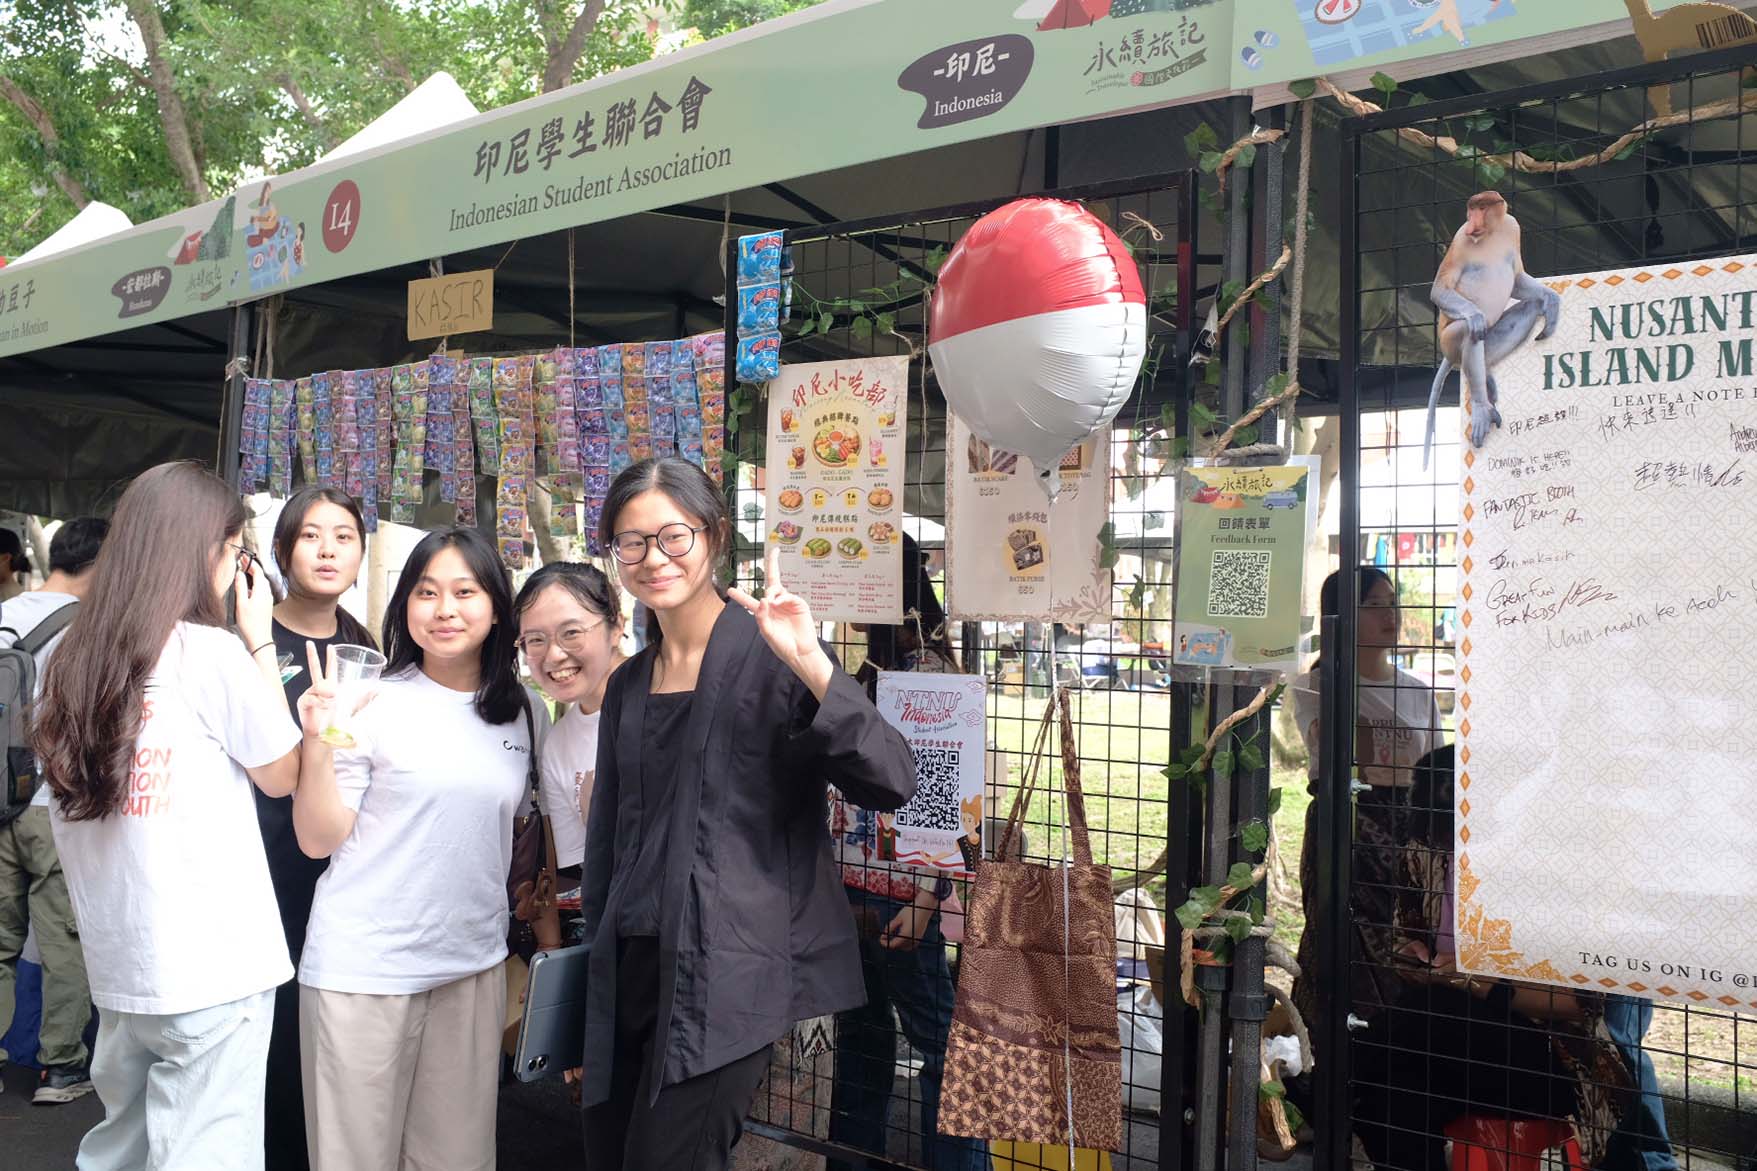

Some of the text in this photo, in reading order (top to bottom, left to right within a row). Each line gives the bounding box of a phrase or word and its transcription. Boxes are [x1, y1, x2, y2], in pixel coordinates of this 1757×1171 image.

[1083, 15, 1205, 76] 永續旅記
[934, 88, 1003, 117] Indonesia
[473, 75, 713, 184] 印尼學生聯合會
[449, 146, 732, 232] Indonesian Student Association
[414, 279, 484, 328] KASIR
[1588, 290, 1757, 342] NUSANT
[1542, 338, 1754, 390] ISLAND M
[1613, 388, 1745, 407] LEAVE A NOTE
[1483, 492, 1539, 519] FANTASTIC
[1546, 485, 1575, 502] BOOTH
[1210, 534, 1277, 544] Feedback Form
[1218, 517, 1271, 530] 回饋表單
[895, 689, 962, 712] NTNU
[901, 703, 952, 724] Indonesia
[1578, 951, 1618, 968] TAG
[1627, 957, 1651, 972] US
[1660, 963, 1691, 978] ON
[1701, 968, 1724, 982] IG
